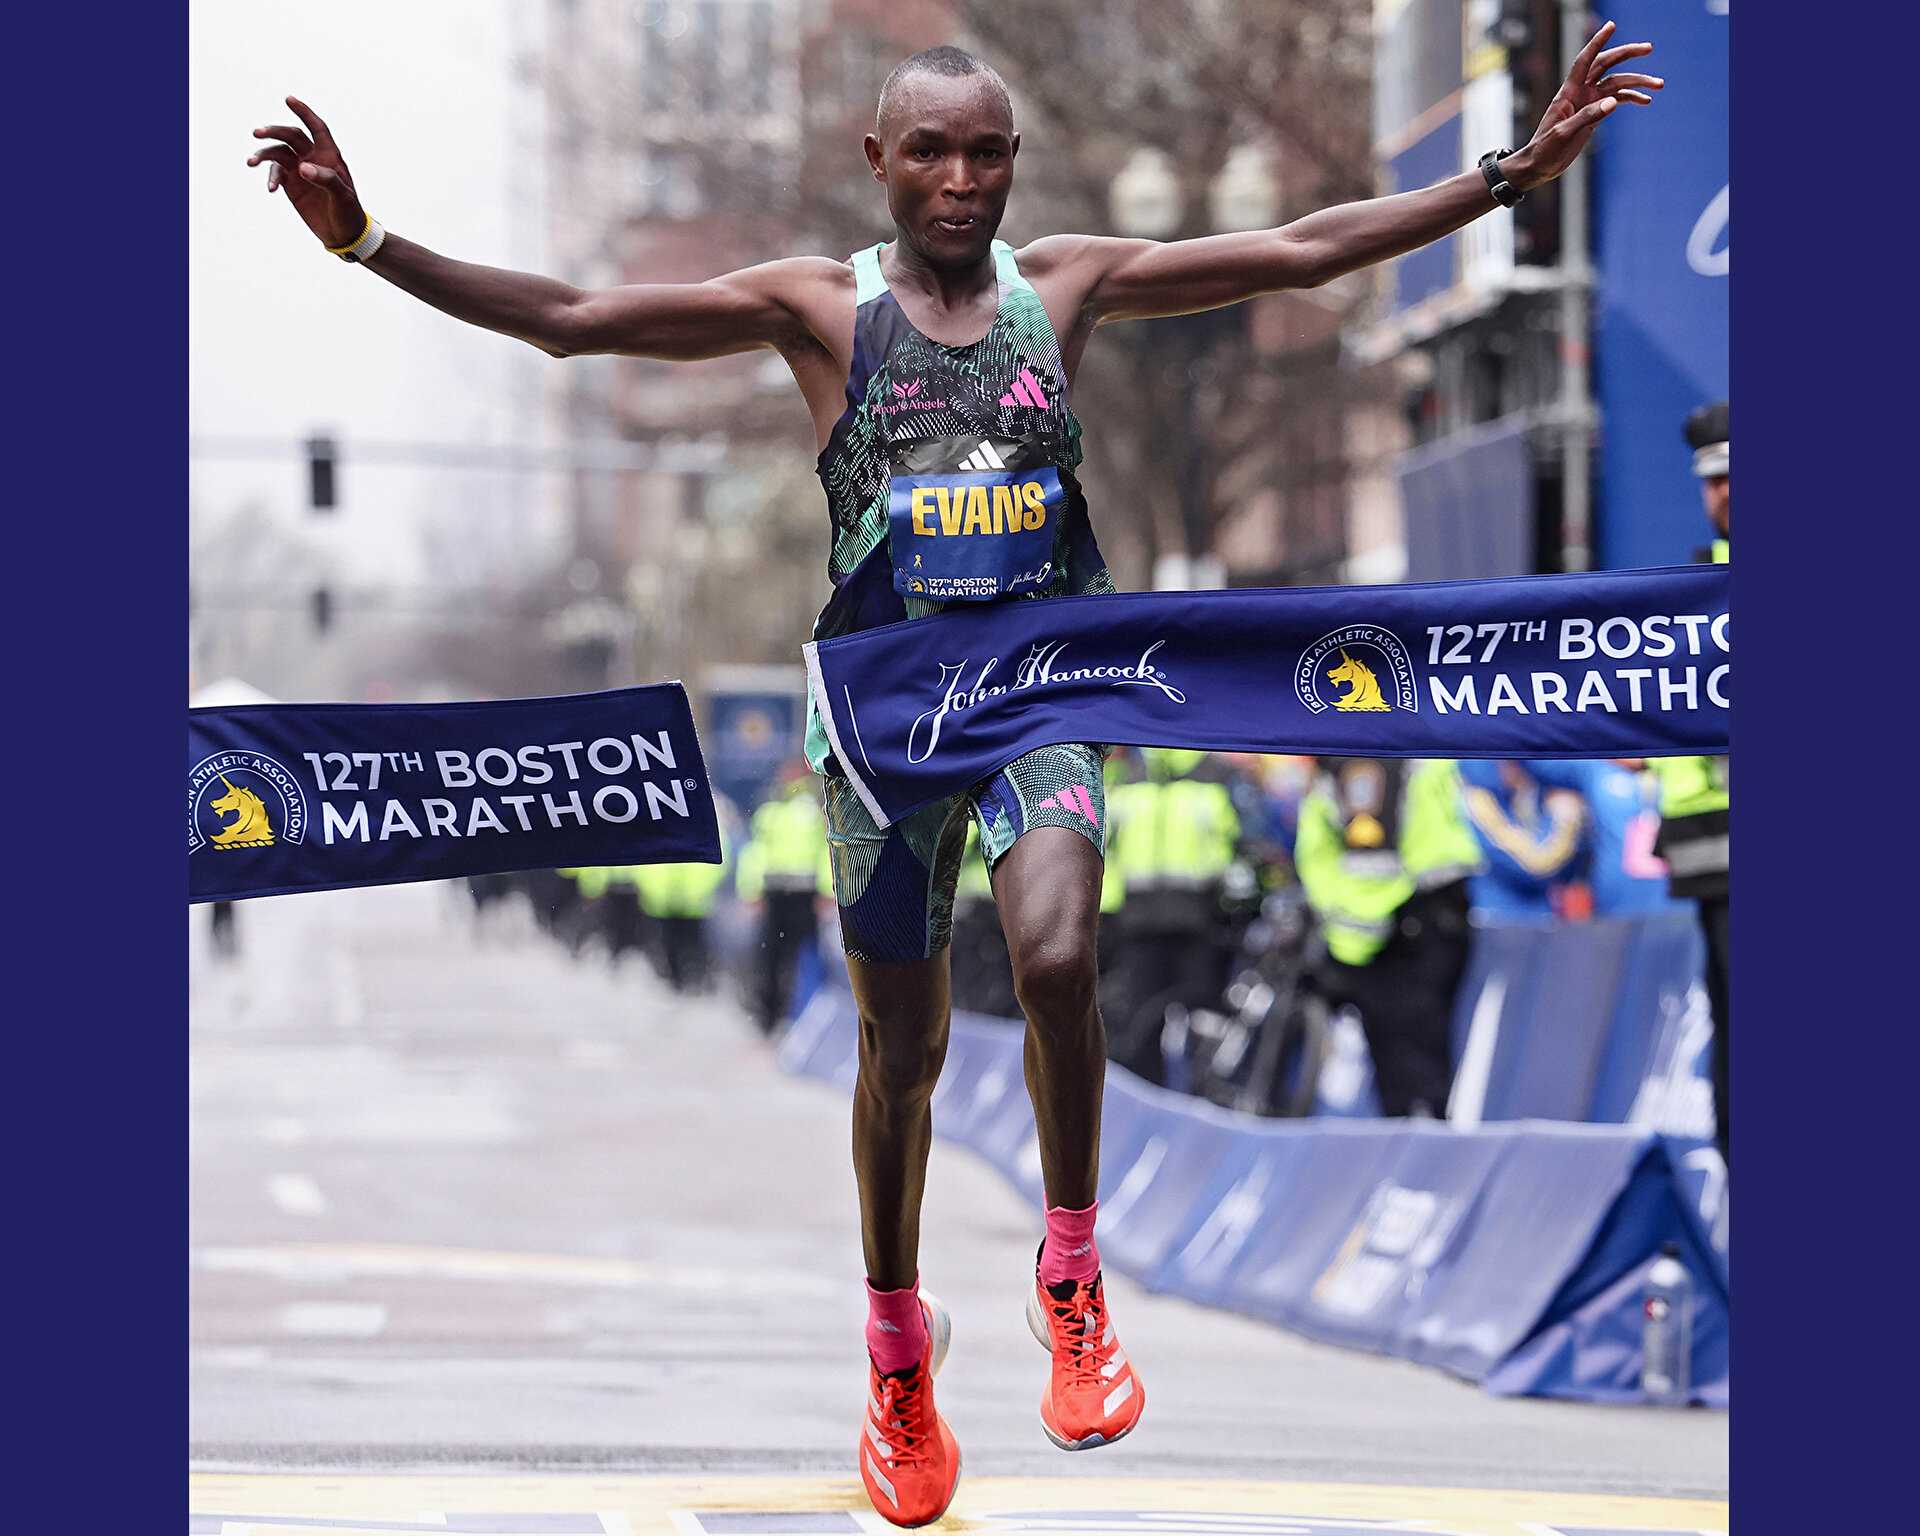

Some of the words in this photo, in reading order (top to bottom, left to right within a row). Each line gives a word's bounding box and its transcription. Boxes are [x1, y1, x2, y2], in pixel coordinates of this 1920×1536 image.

[909, 398, 947, 411] Angels
[911, 481, 1047, 537] EVANS
[927, 577, 951, 587] 127TH
[953, 577, 997, 587] BOSTON
[929, 586, 998, 597] MARATHON
[1300, 656, 1322, 709] BOSTON
[1314, 630, 1374, 657] ATHLETIC
[1375, 634, 1413, 709] ASSOCIATION
[1426, 620, 1547, 665] 127TH
[907, 657, 1007, 764] John
[303, 752, 424, 791] 127TH
[435, 731, 677, 788] BOSTON
[192, 756, 249, 788] ATHLETIC
[252, 759, 302, 839] ASSOCIATION
